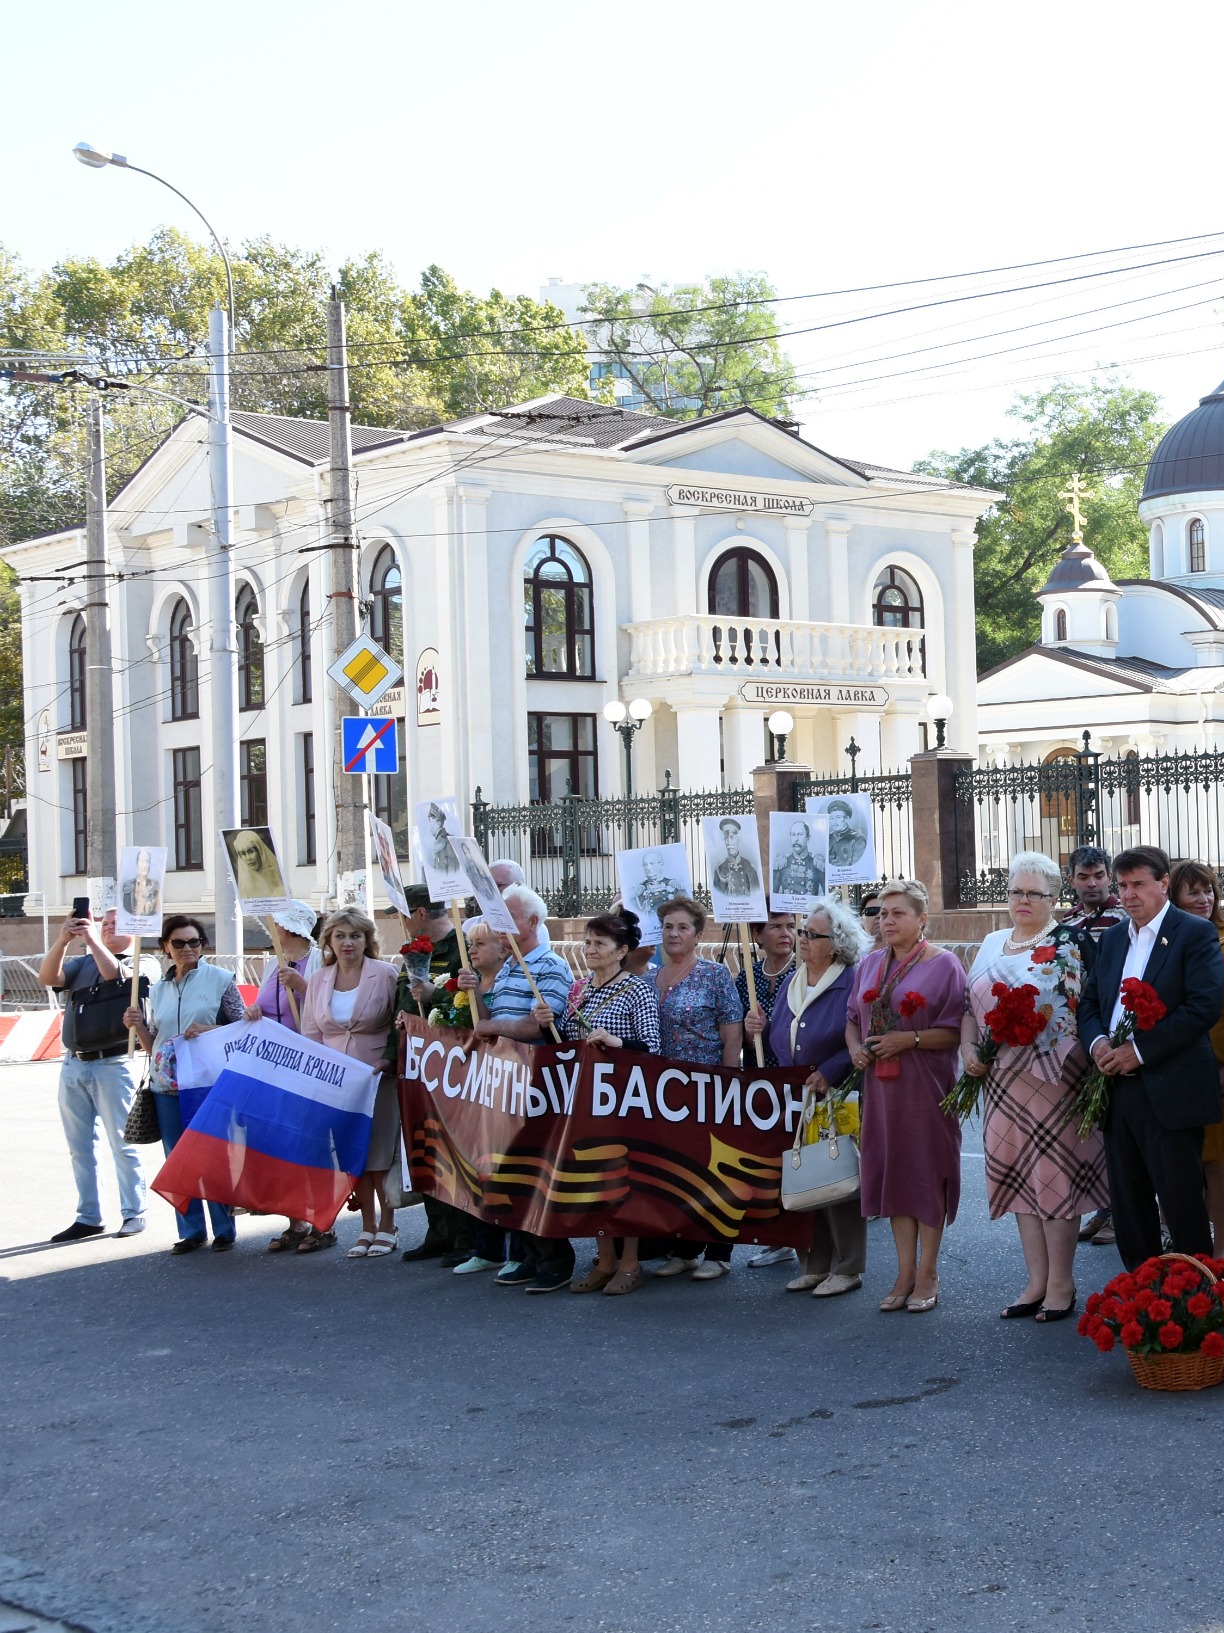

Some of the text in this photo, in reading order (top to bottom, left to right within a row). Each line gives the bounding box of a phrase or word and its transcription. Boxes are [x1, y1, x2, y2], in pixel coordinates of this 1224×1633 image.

[678, 488, 805, 512] ВОСКРЕСНАЯ ШКОЛА
[755, 686, 876, 702] ЦЕРКОВНАЯ ЛАВКА
[256, 1039, 304, 1072] ОБЩИНА
[302, 1054, 346, 1087] КРЫМА
[405, 1035, 808, 1132] БССМЕРТНЫЙ БАСТИОН
